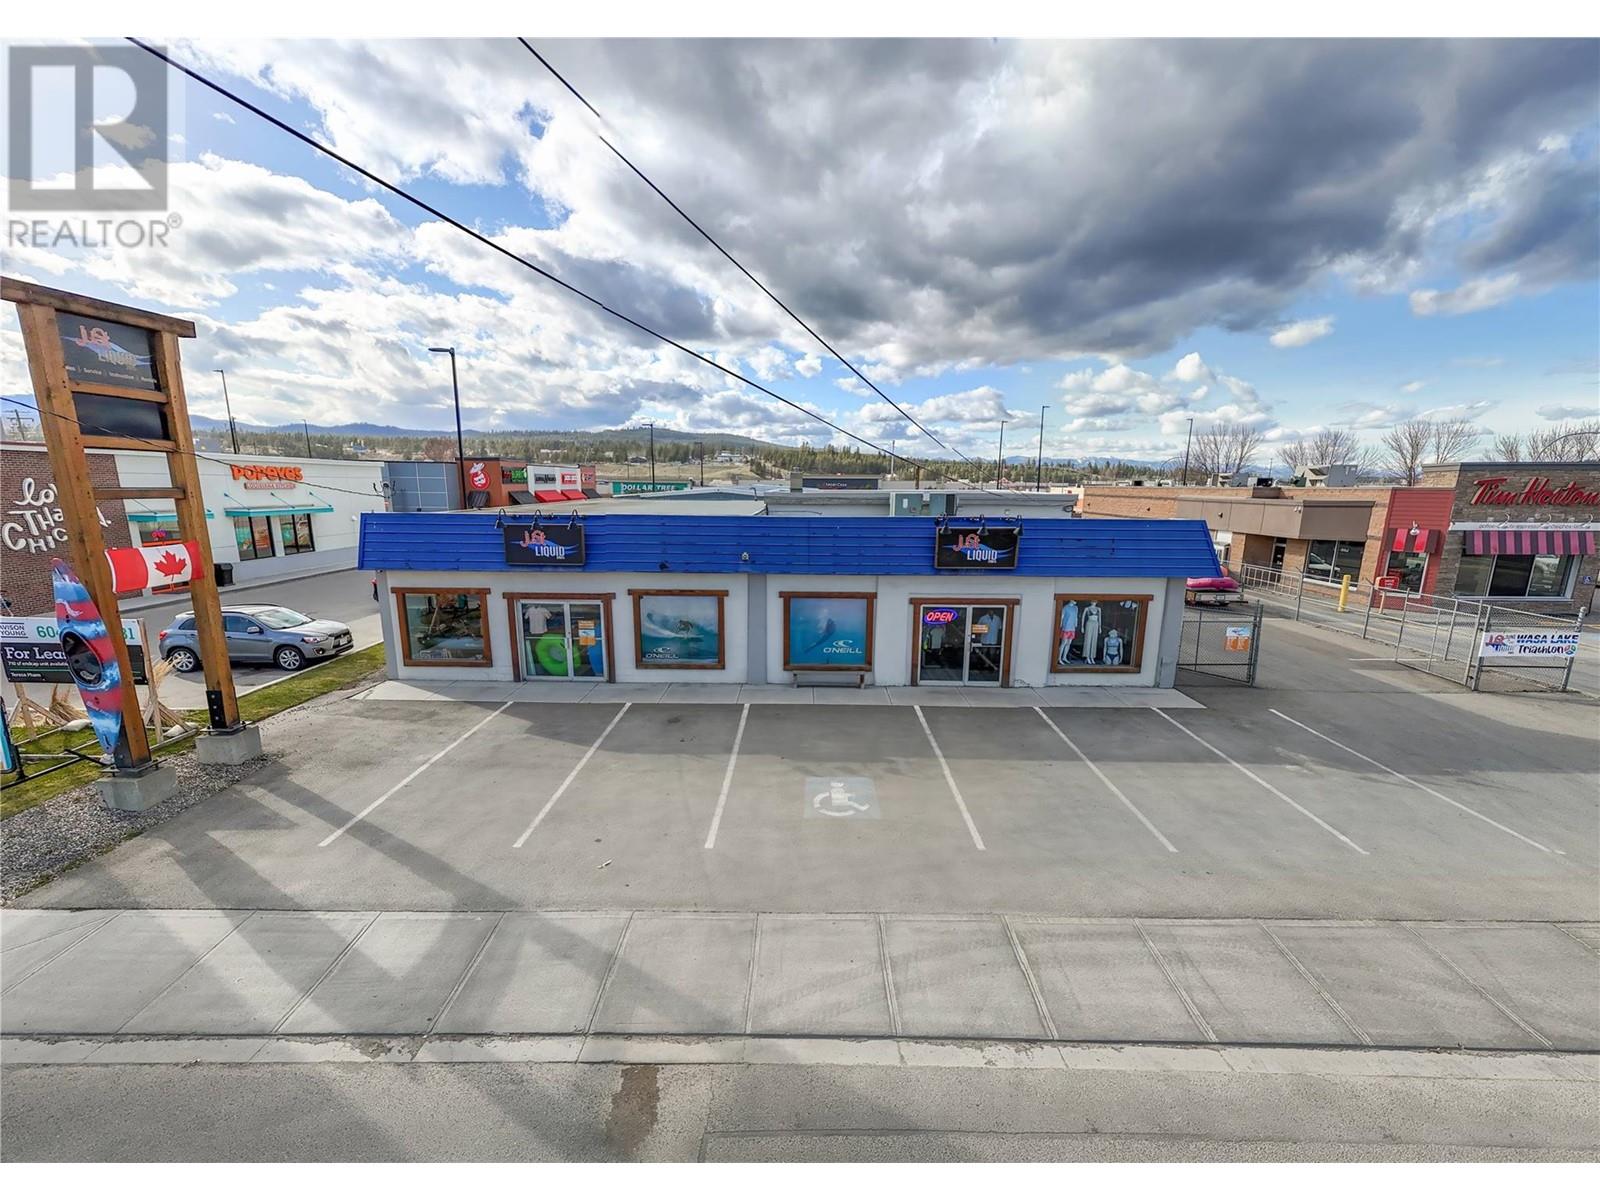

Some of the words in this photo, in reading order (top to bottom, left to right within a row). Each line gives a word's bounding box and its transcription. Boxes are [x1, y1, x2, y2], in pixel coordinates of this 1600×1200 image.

[622, 483, 653, 491] DOLLAR
[1470, 477, 1518, 505] Tim
[1520, 476, 1600, 506] Horton
[535, 546, 565, 557] LIQUID
[967, 550, 998, 561] LIQUID
[926, 612, 954, 622] OPEN
[1516, 634, 1547, 643] WASA
[1550, 634, 1579, 644] LAKE
[4, 647, 30, 659] For
[32, 647, 67, 659] Lea
[1518, 645, 1564, 654] Triathlon
